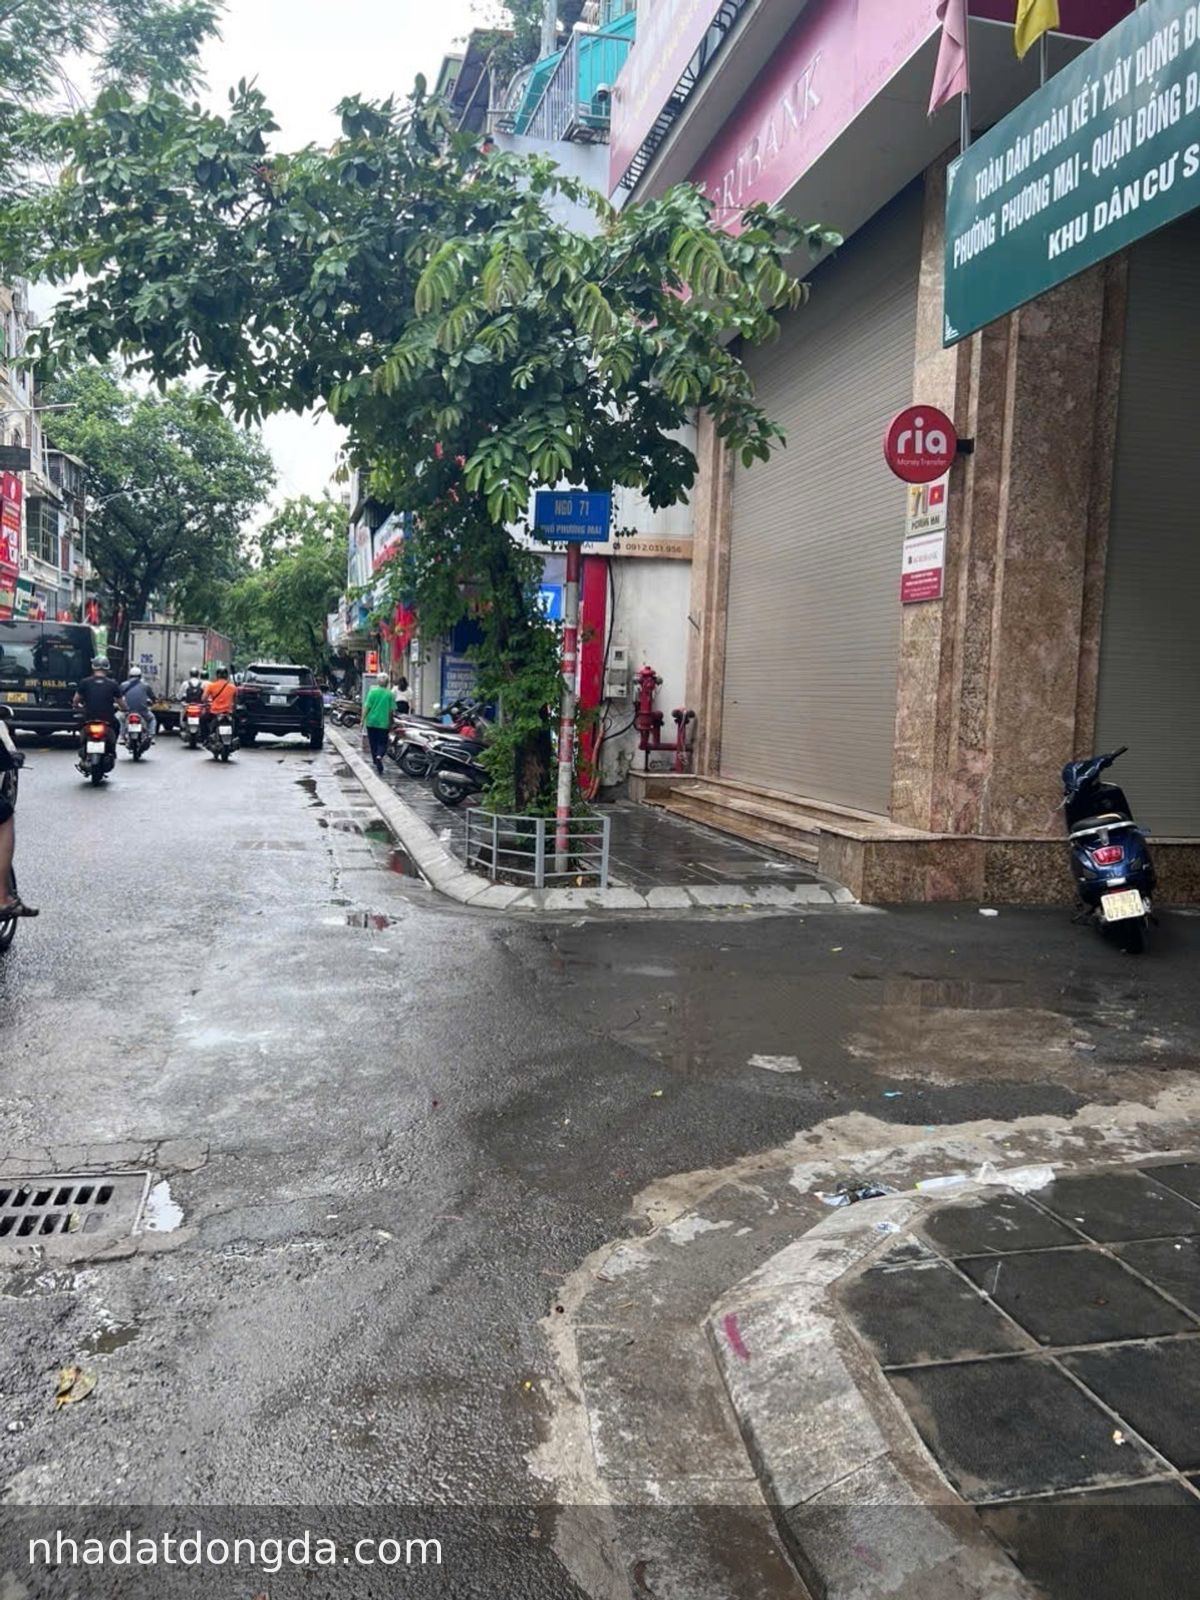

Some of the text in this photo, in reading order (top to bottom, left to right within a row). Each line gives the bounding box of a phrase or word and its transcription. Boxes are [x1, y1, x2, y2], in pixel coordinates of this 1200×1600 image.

[975, 6, 1200, 204] TOÀN DÂN ĐOÀN KẾT XÂY DỰNG Đ
[953, 212, 996, 269] PHƯỜNG
[1001, 173, 1050, 237] PHƯƠNG
[1053, 152, 1080, 202] MAI
[1091, 115, 1133, 177] QUẬN
[1136, 81, 1181, 147] ĐỐNG
[1185, 72, 1200, 115] Đ
[1048, 211, 1088, 260] KHU
[1093, 185, 1140, 233] DÂN
[1142, 151, 1179, 201] CƯ
[897, 416, 947, 454] ria
[897, 457, 947, 468] Money Transfer
[579, 500, 590, 516] 71
[586, 524, 602, 535] MAI
